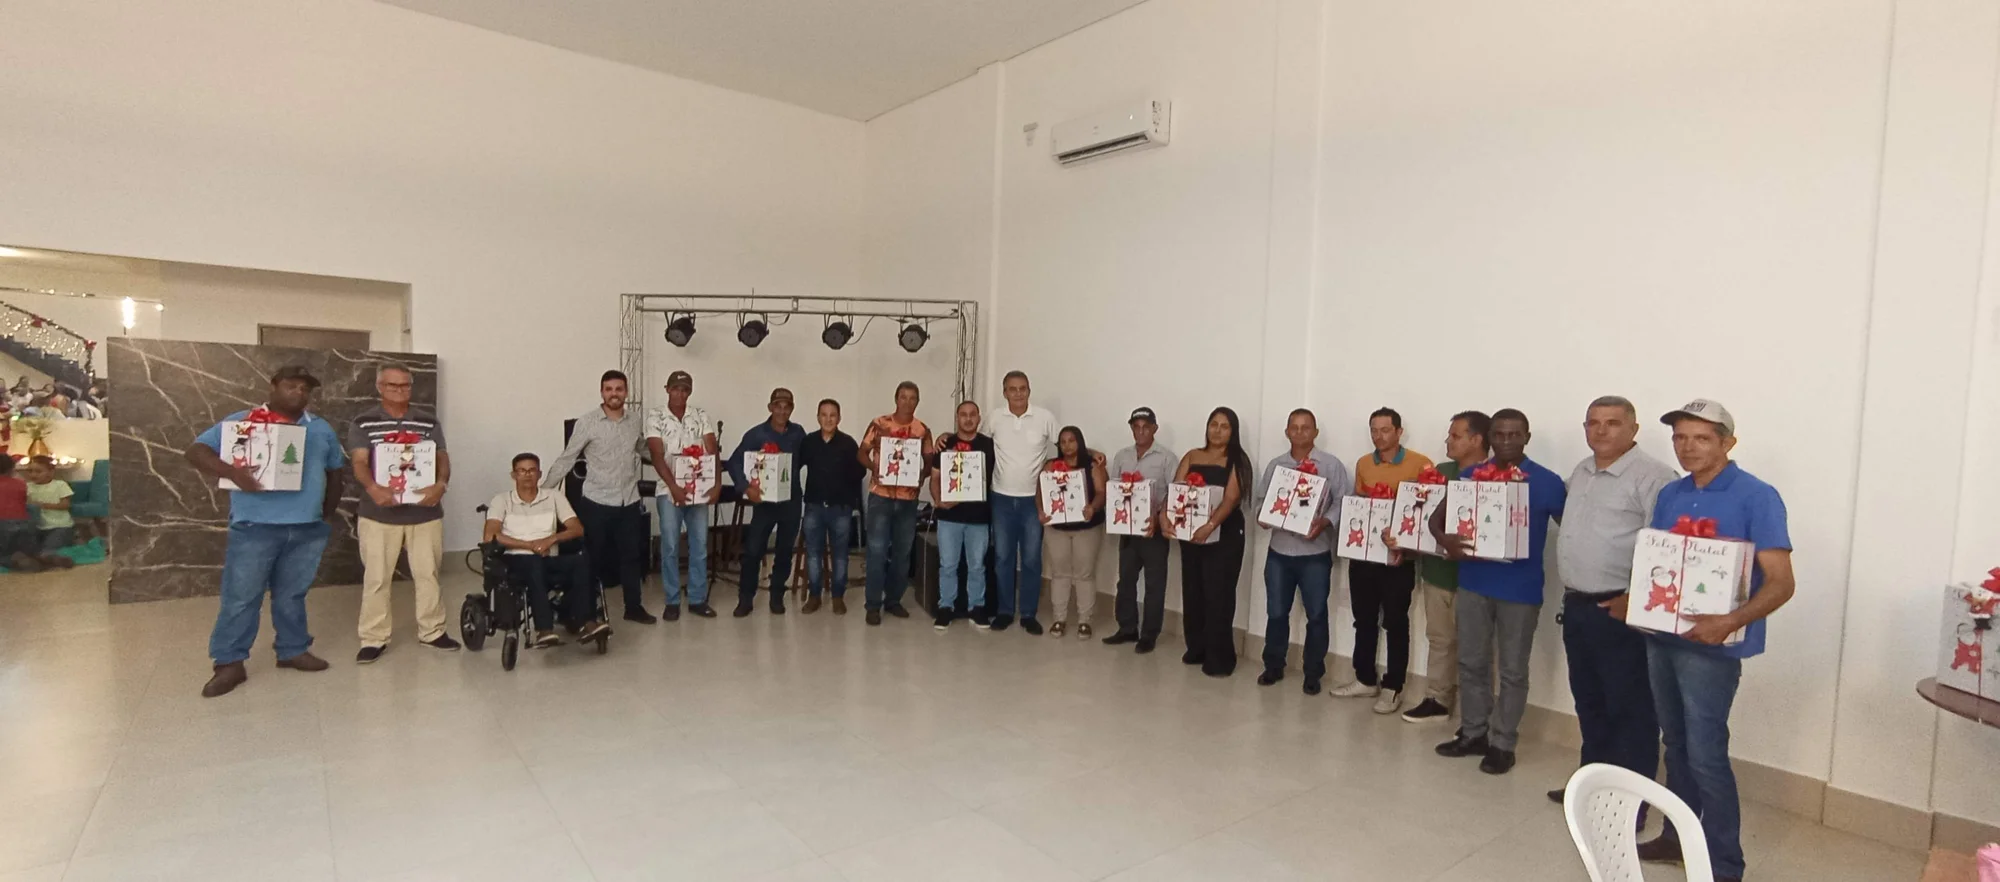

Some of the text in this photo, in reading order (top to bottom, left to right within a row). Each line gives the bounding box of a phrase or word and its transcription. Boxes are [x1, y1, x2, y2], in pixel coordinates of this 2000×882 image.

[1453, 482, 1502, 496] Feliz Natal
[1644, 534, 1728, 557] Feliz Natal
